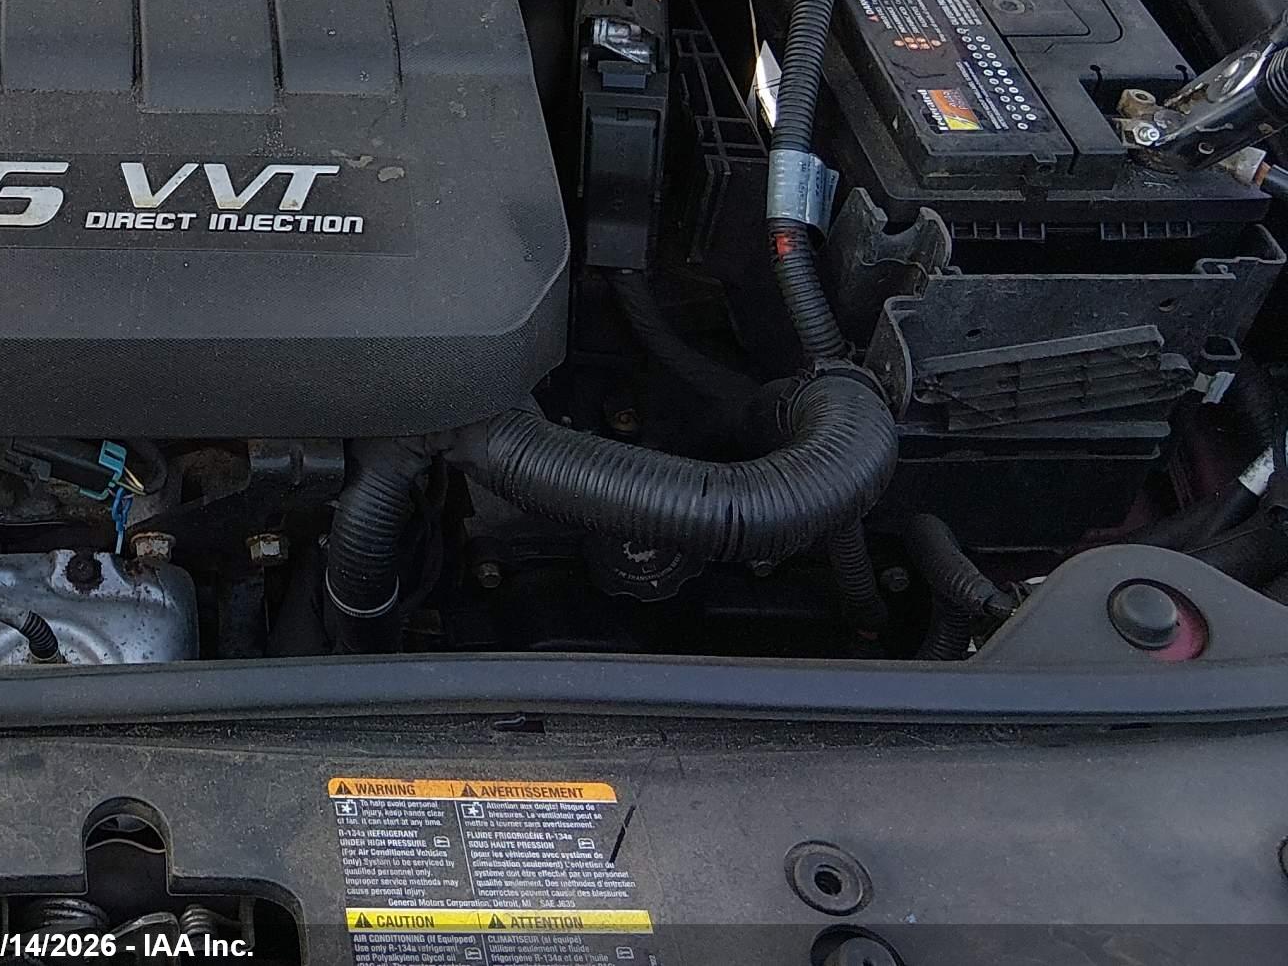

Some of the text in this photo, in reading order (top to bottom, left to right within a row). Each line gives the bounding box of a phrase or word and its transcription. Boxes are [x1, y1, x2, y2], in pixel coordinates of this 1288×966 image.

[121, 163, 340, 211] VVT
[85, 212, 364, 233] DIRECT INJECTION
[355, 784, 416, 795] WARNING
[481, 786, 583, 798] AVERTISSEMENT
[367, 830, 418, 838] REFRIGERANT
[466, 831, 493, 839] FLUIDE
[367, 839, 385, 847] HIGH
[387, 839, 427, 847] PRESSURE
[517, 841, 555, 849] PRESSION
[363, 858, 391, 868] System
[413, 859, 444, 868] serviced
[445, 859, 454, 868] by
[569, 871, 581, 879] par
[409, 878, 441, 886] methods
[371, 888, 402, 896] personal
[388, 898, 417, 906] General
[446, 899, 491, 908] Corporation,
[493, 900, 521, 908] Detroit,
[377, 915, 435, 928] CAUTION
[511, 916, 584, 929] ATTENTION
[354, 935, 367, 943] AIR
[369, 935, 425, 943] CONDITIONING
[438, 935, 476, 944] Equipped)
[354, 944, 458, 954] Use only R-134a refrigerant
[372, 954, 420, 962] Polyalkylene
[422, 954, 444, 962] Glycol
